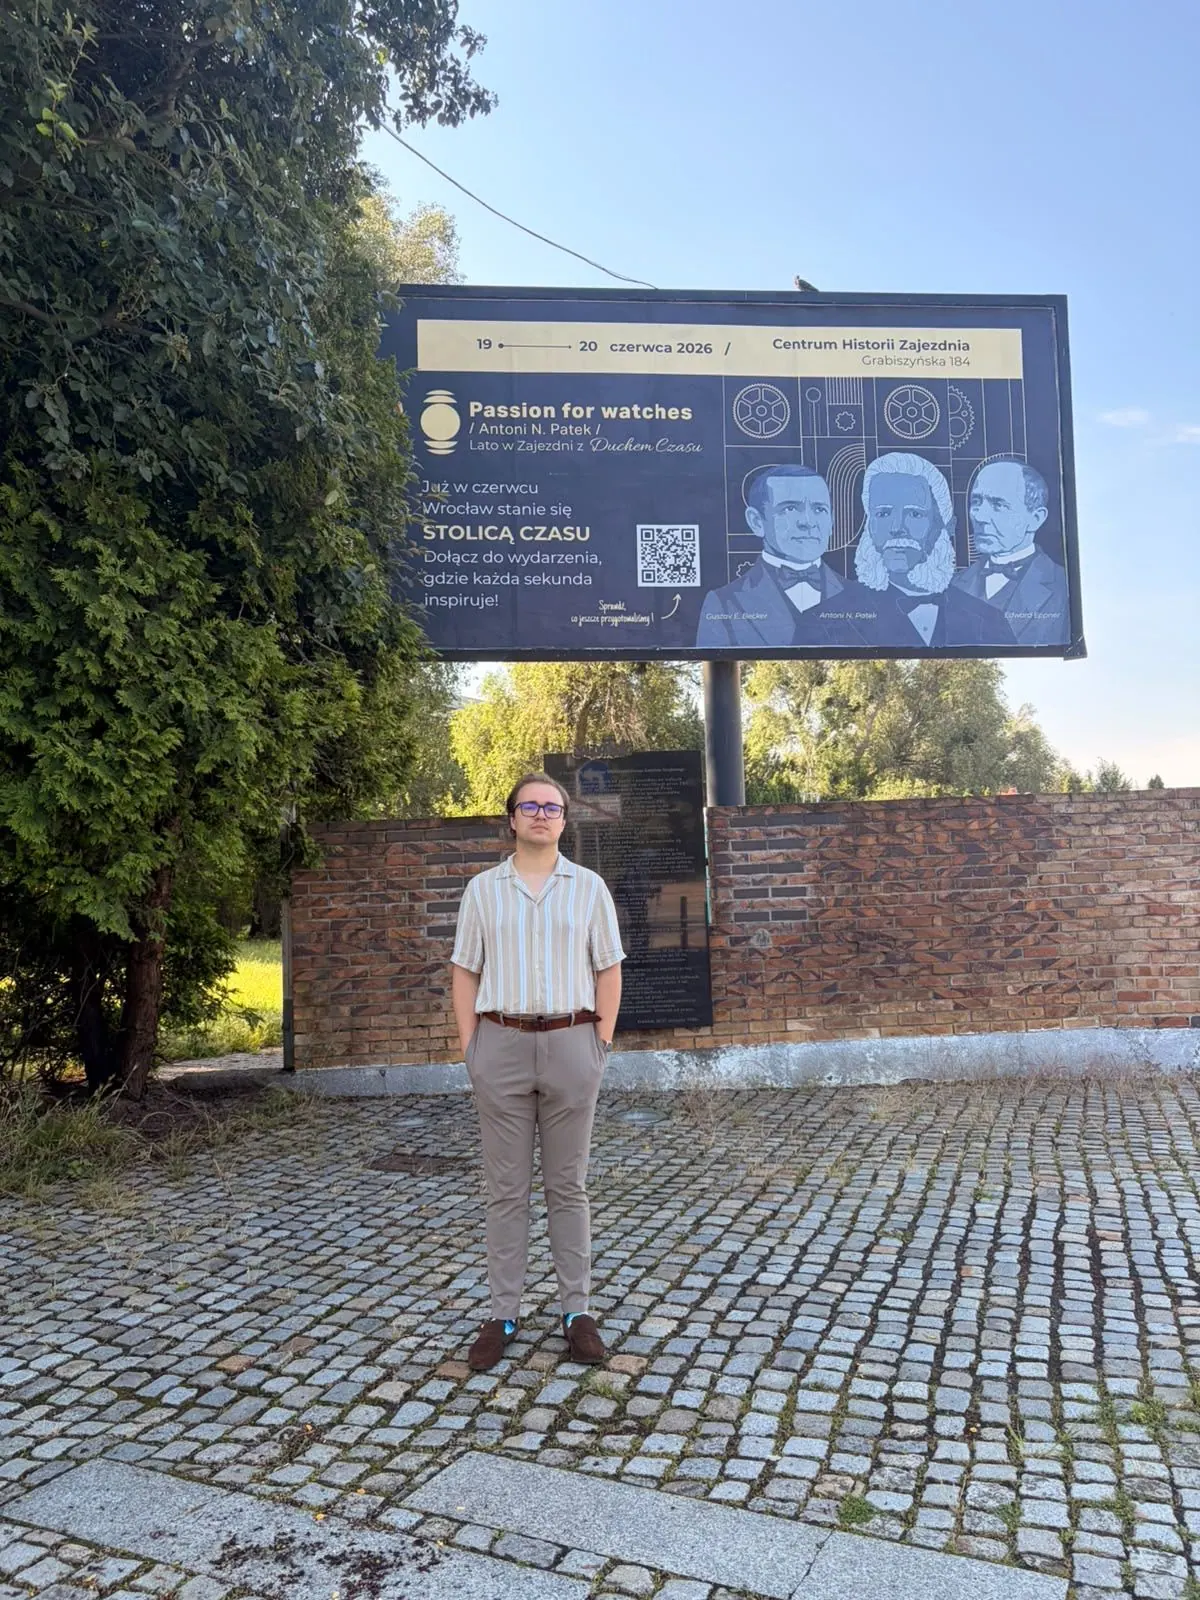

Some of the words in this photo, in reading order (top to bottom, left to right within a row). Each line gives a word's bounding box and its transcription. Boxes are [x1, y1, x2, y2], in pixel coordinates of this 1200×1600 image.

[476, 338, 492, 349] 19
[579, 341, 598, 352] 20
[610, 342, 672, 353] czerwca
[677, 343, 713, 354] 2026
[772, 338, 838, 351] Centrum
[842, 339, 895, 351] Historii
[899, 340, 970, 353] Zajezdnia
[862, 355, 946, 368] Grabiszyńska
[950, 356, 970, 367] 184
[469, 402, 556, 418] Passion
[562, 403, 595, 418] for
[601, 404, 693, 420] watches
[479, 423, 527, 435] Antoni
[531, 424, 546, 435] N.
[550, 424, 592, 436] Patek
[469, 440, 499, 451] Lato
[501, 443, 514, 451] w
[517, 440, 574, 453] Zajezdni
[589, 437, 653, 453] Duchem
[655, 438, 703, 453] Czasu
[422, 480, 449, 493] Już
[453, 483, 468, 493] w
[472, 483, 538, 494] czerwcu
[422, 502, 494, 515] Wrocław
[498, 503, 546, 516] stanie
[550, 503, 572, 519] się
[423, 525, 515, 544] STOLICĄ
[520, 526, 591, 542] CZASU
[424, 550, 478, 565] Dołącz
[482, 551, 504, 564] do
[507, 552, 602, 567] wydarzenia,
[424, 572, 469, 587] gdzie
[473, 572, 519, 585] każda
[524, 573, 592, 586] sekunda
[424, 593, 499, 609] inspiruje!
